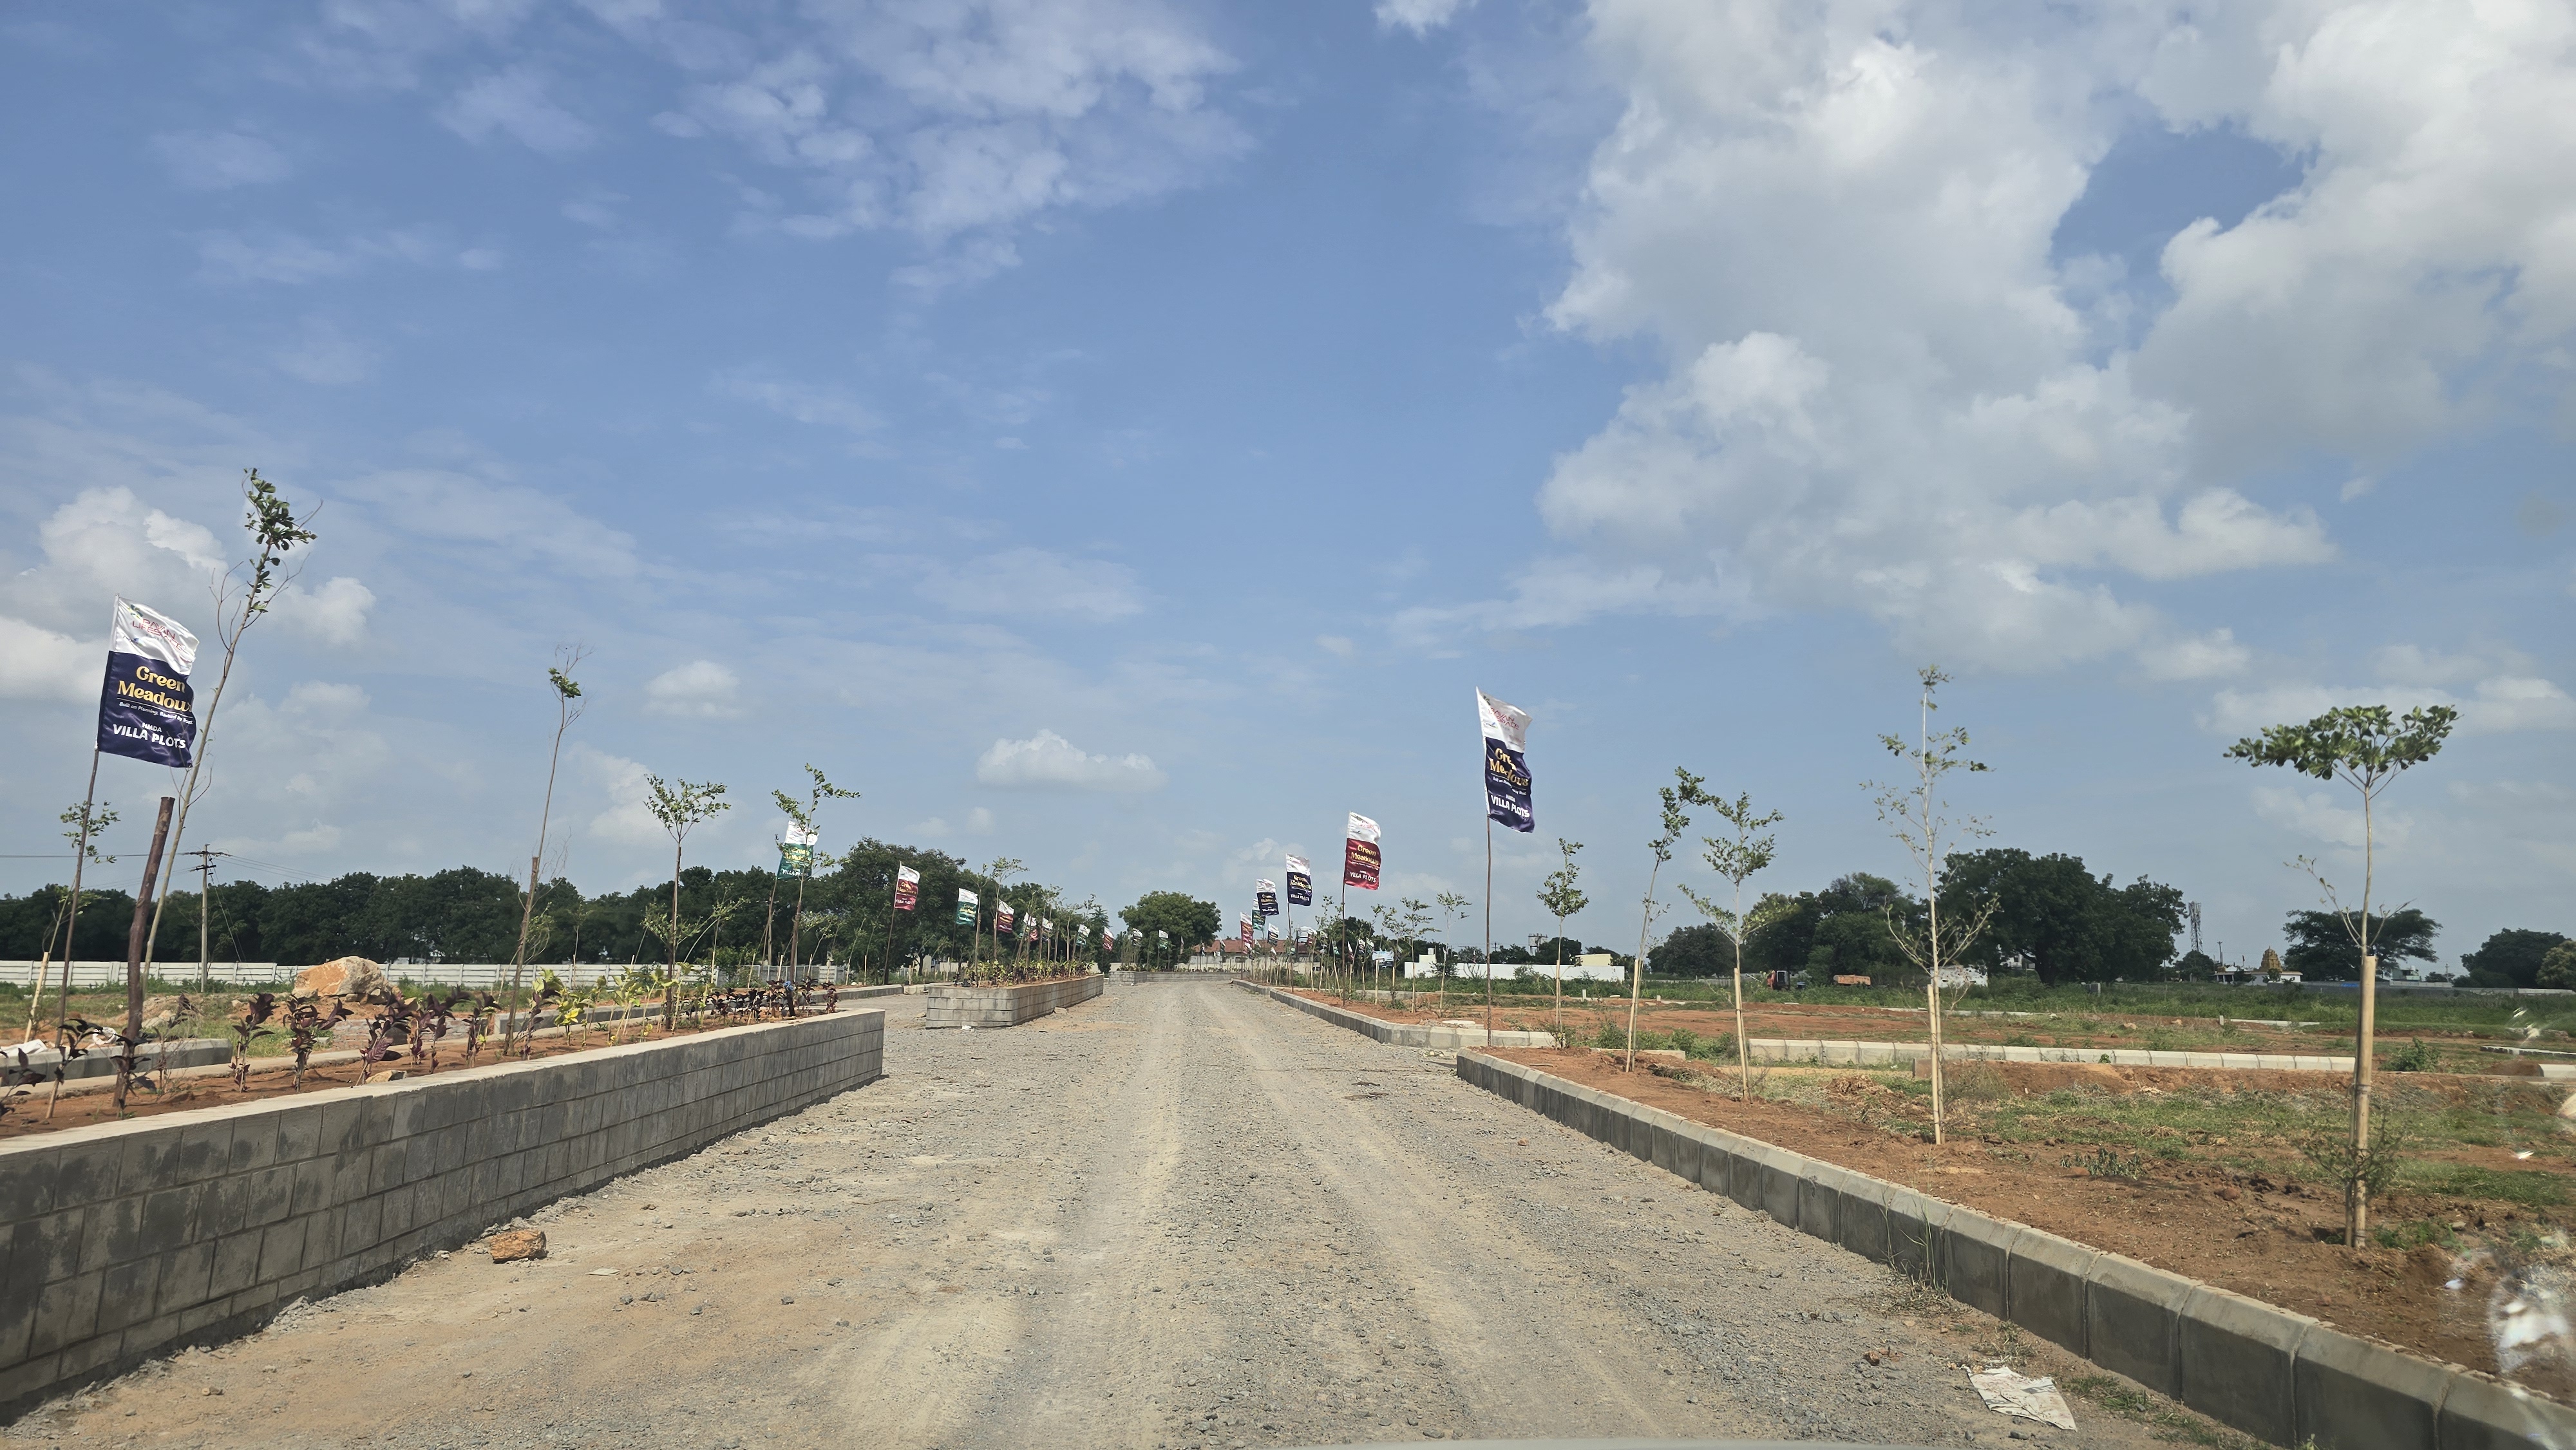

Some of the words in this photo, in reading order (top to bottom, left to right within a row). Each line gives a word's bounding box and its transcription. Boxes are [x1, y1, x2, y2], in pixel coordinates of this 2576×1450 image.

[136, 666, 186, 693] Green
[113, 724, 148, 740] VILLA
[151, 733, 186, 749] PLOTS
[1491, 795, 1510, 811] VILLA
[1511, 802, 1530, 818] PLOTS
[1363, 874, 1376, 883] PLOTS
